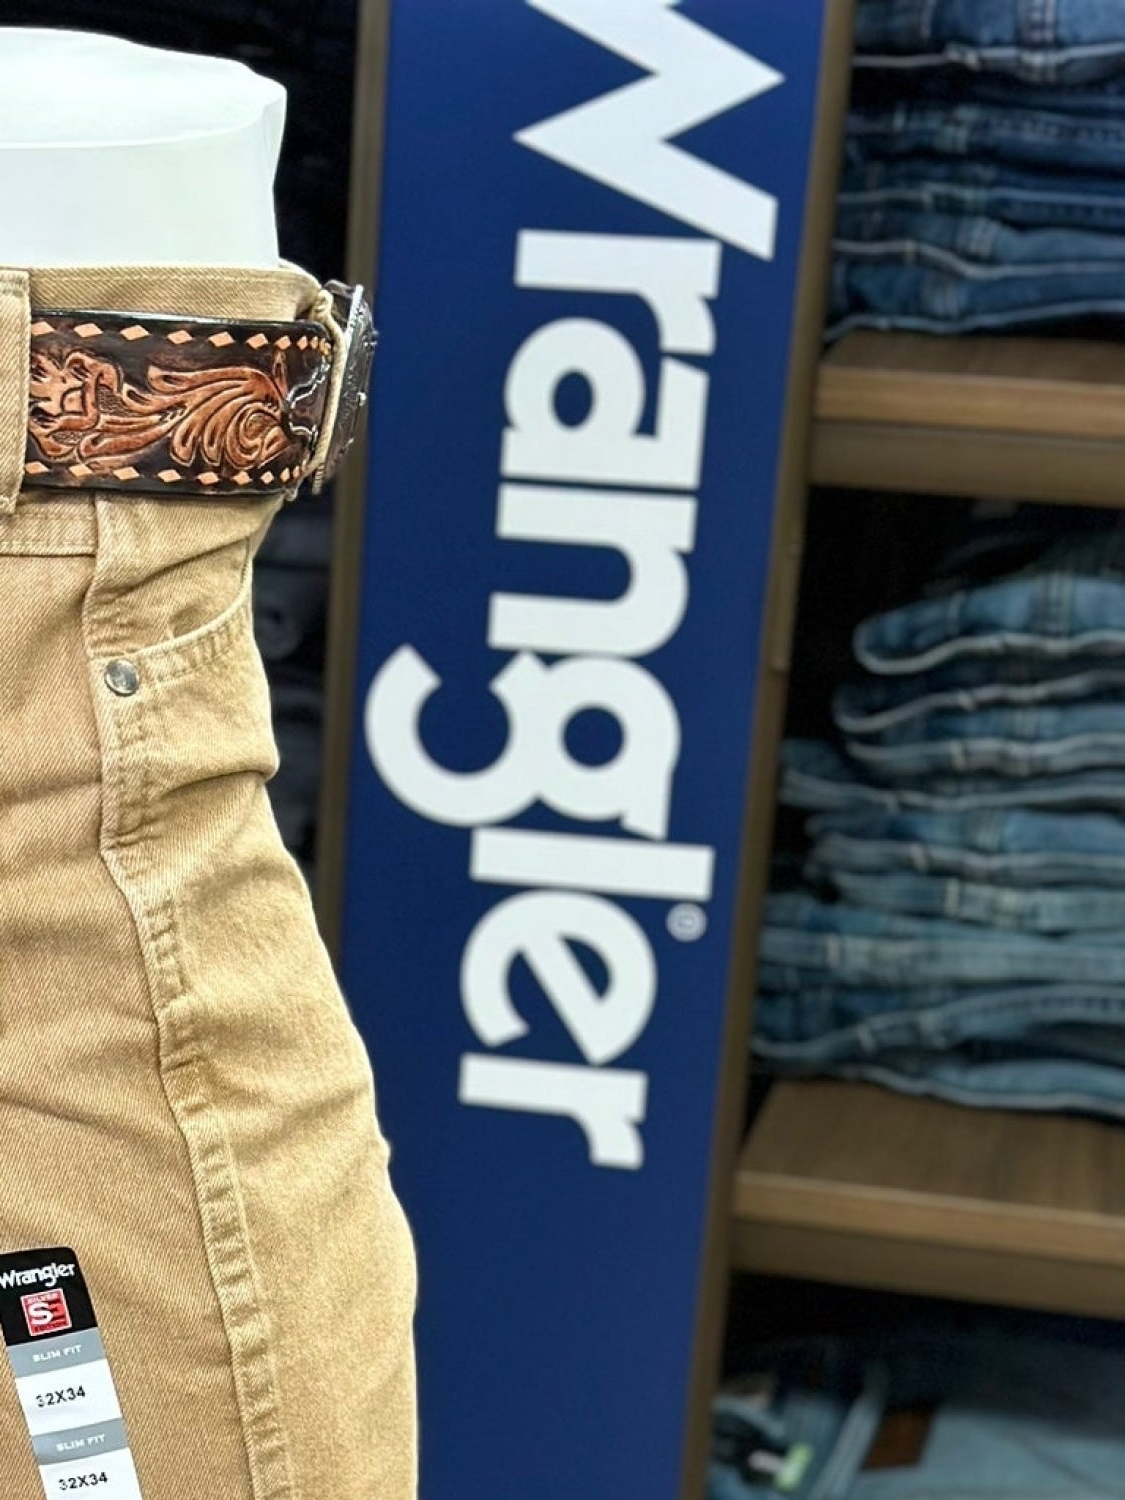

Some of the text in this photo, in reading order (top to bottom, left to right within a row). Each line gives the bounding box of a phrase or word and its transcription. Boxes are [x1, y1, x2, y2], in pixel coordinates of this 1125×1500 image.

[364, 0, 786, 1170] Wrangler
[32, 1345, 83, 1362] SLIM FIT
[55, 1434, 106, 1451] SLIM FIT
[58, 1471, 108, 1491] 32X34
